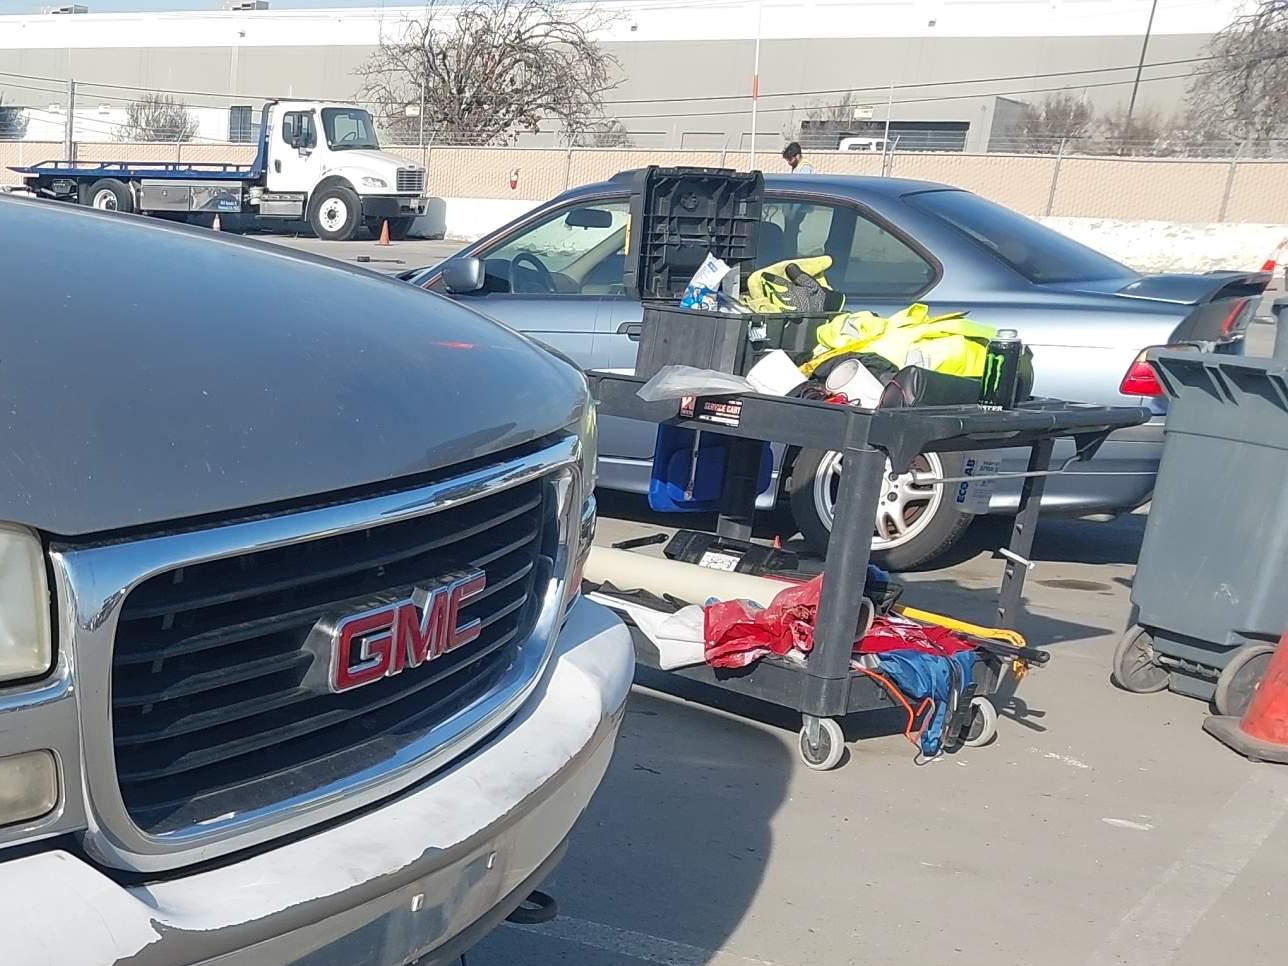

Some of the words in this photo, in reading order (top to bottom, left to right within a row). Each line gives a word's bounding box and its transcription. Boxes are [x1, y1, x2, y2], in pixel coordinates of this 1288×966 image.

[703, 401, 727, 413] SERVICE
[726, 404, 741, 416] CART
[956, 459, 976, 503] ECOAB
[328, 566, 488, 694] GMC
